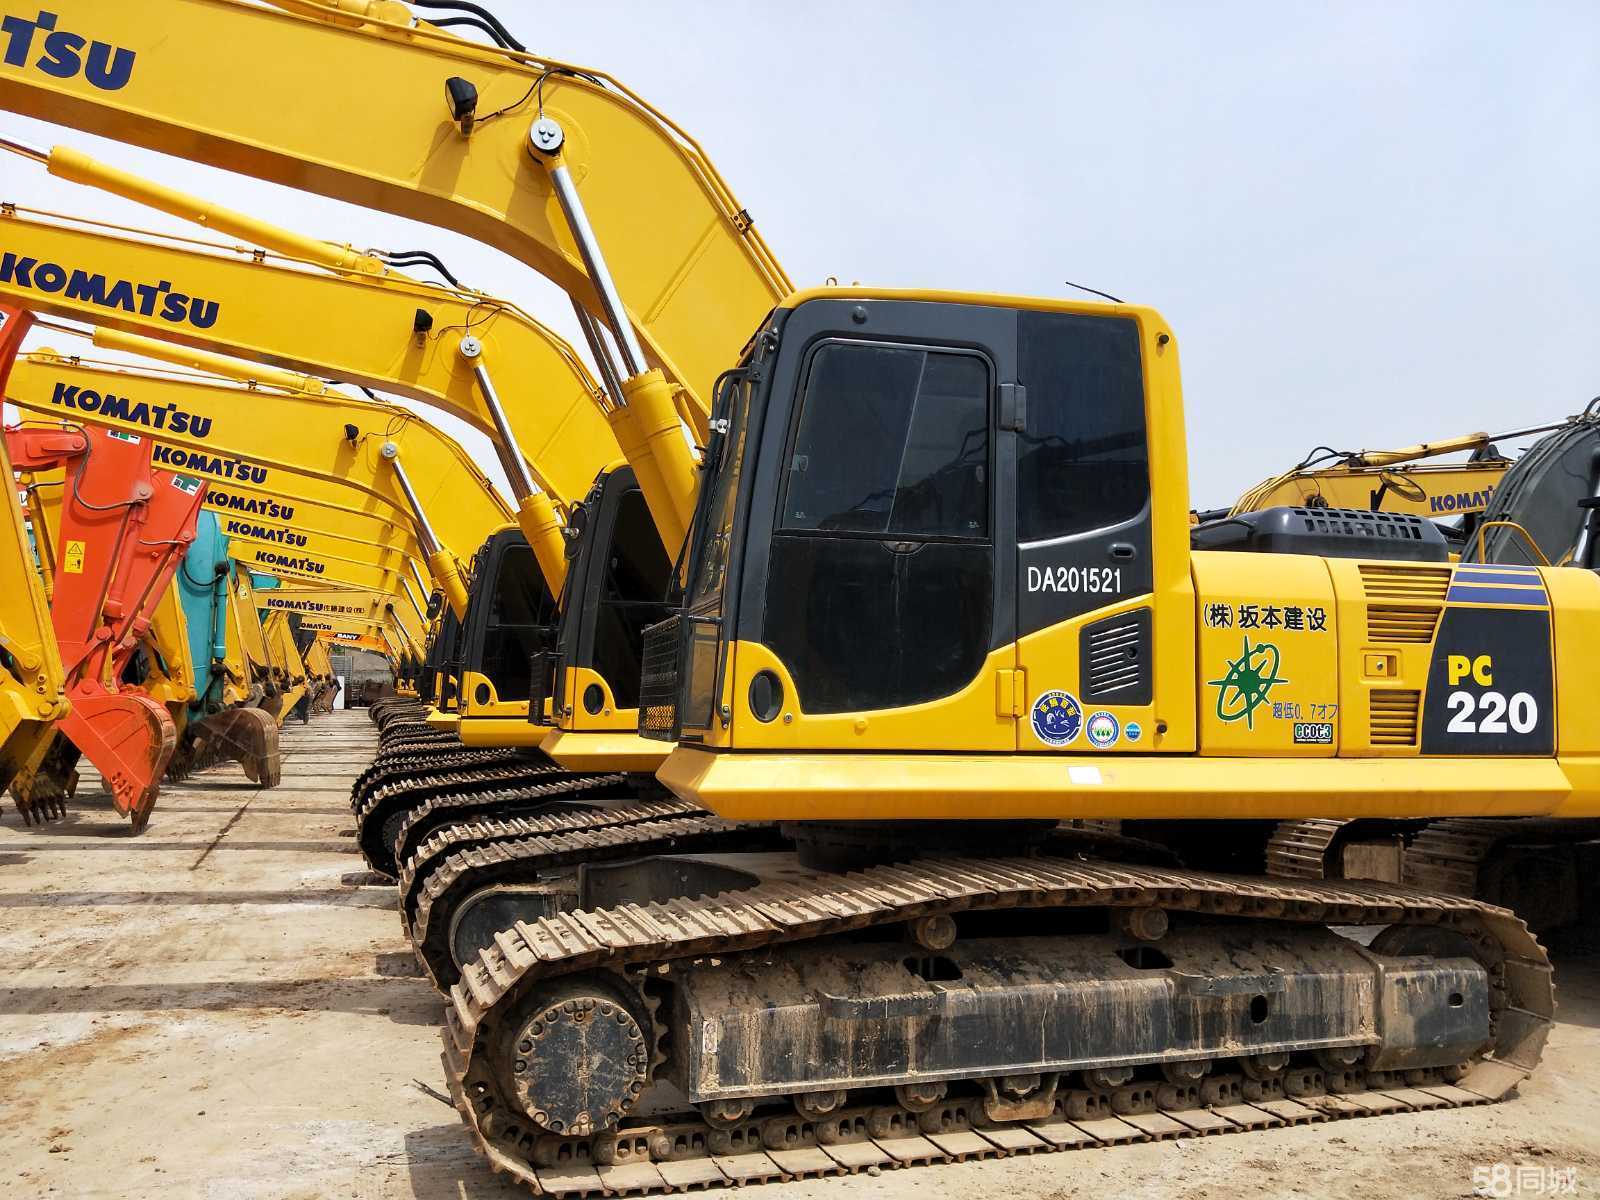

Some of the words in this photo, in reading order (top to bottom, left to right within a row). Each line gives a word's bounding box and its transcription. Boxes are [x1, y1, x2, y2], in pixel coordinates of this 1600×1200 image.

[0, 252, 220, 329] KOMATSU
[51, 382, 212, 438] KOMATSU
[153, 445, 268, 484] KOMATSU
[204, 491, 294, 520] KOMATSU
[1430, 485, 1494, 512] KOMAT
[227, 521, 308, 547] KOMATSU
[255, 550, 325, 573] KOMATSU
[1027, 566, 1121, 593] DA201521
[267, 598, 323, 611] KOMATSU
[301, 622, 332, 631] OMATSU
[1448, 655, 1493, 686] PC
[1447, 691, 1538, 734] 220
[1295, 724, 1332, 739] ecot3
